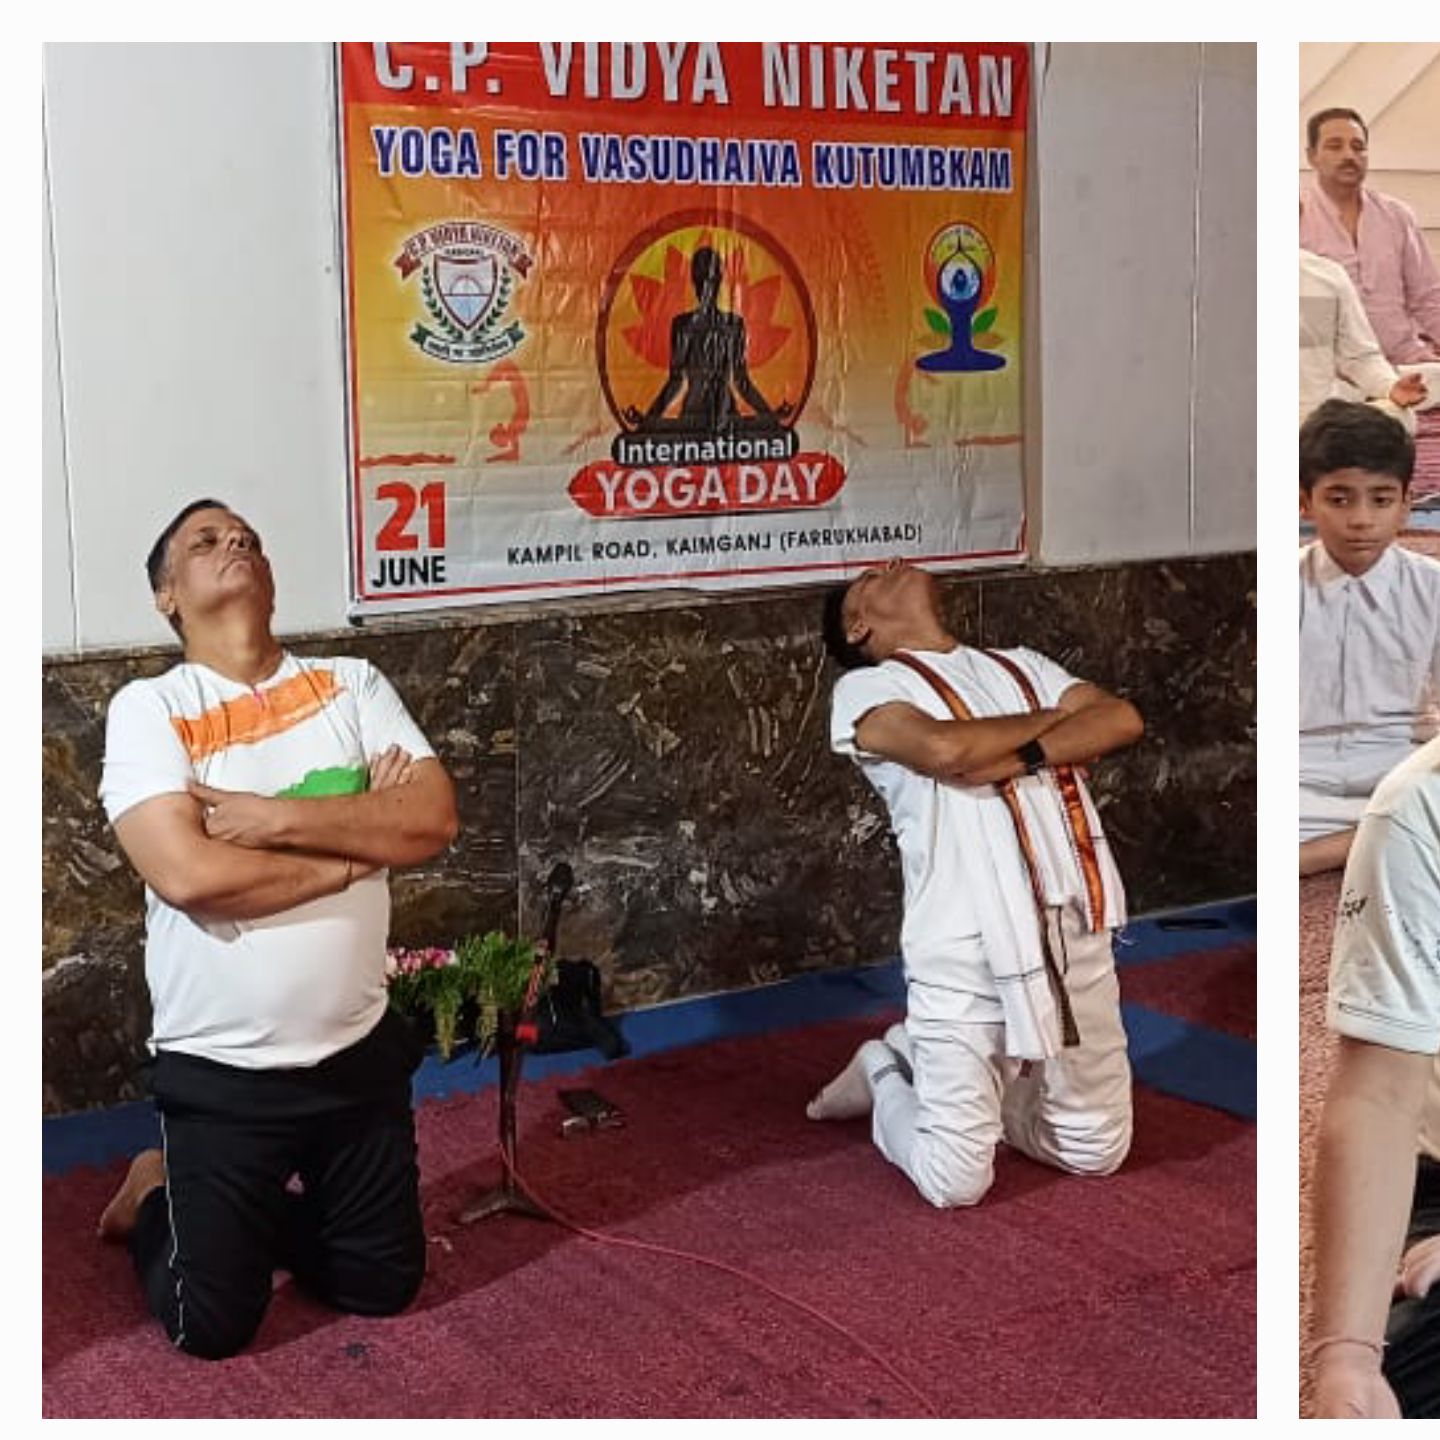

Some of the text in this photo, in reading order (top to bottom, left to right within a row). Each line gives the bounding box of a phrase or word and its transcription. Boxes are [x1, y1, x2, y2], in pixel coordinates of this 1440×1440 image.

[374, 42, 1012, 116] C.P. VIDYA NIKETAN
[373, 127, 1011, 189] YOGA FOR VASUDHAIVA KUTUMBKAM
[618, 434, 793, 464] International
[597, 461, 825, 511] YOGA DAY
[375, 480, 445, 551] 21
[507, 523, 922, 566] KAMPIL ROAD, KAIMGANJ (FARRUKHABAD)
[371, 555, 446, 588] JUNE
